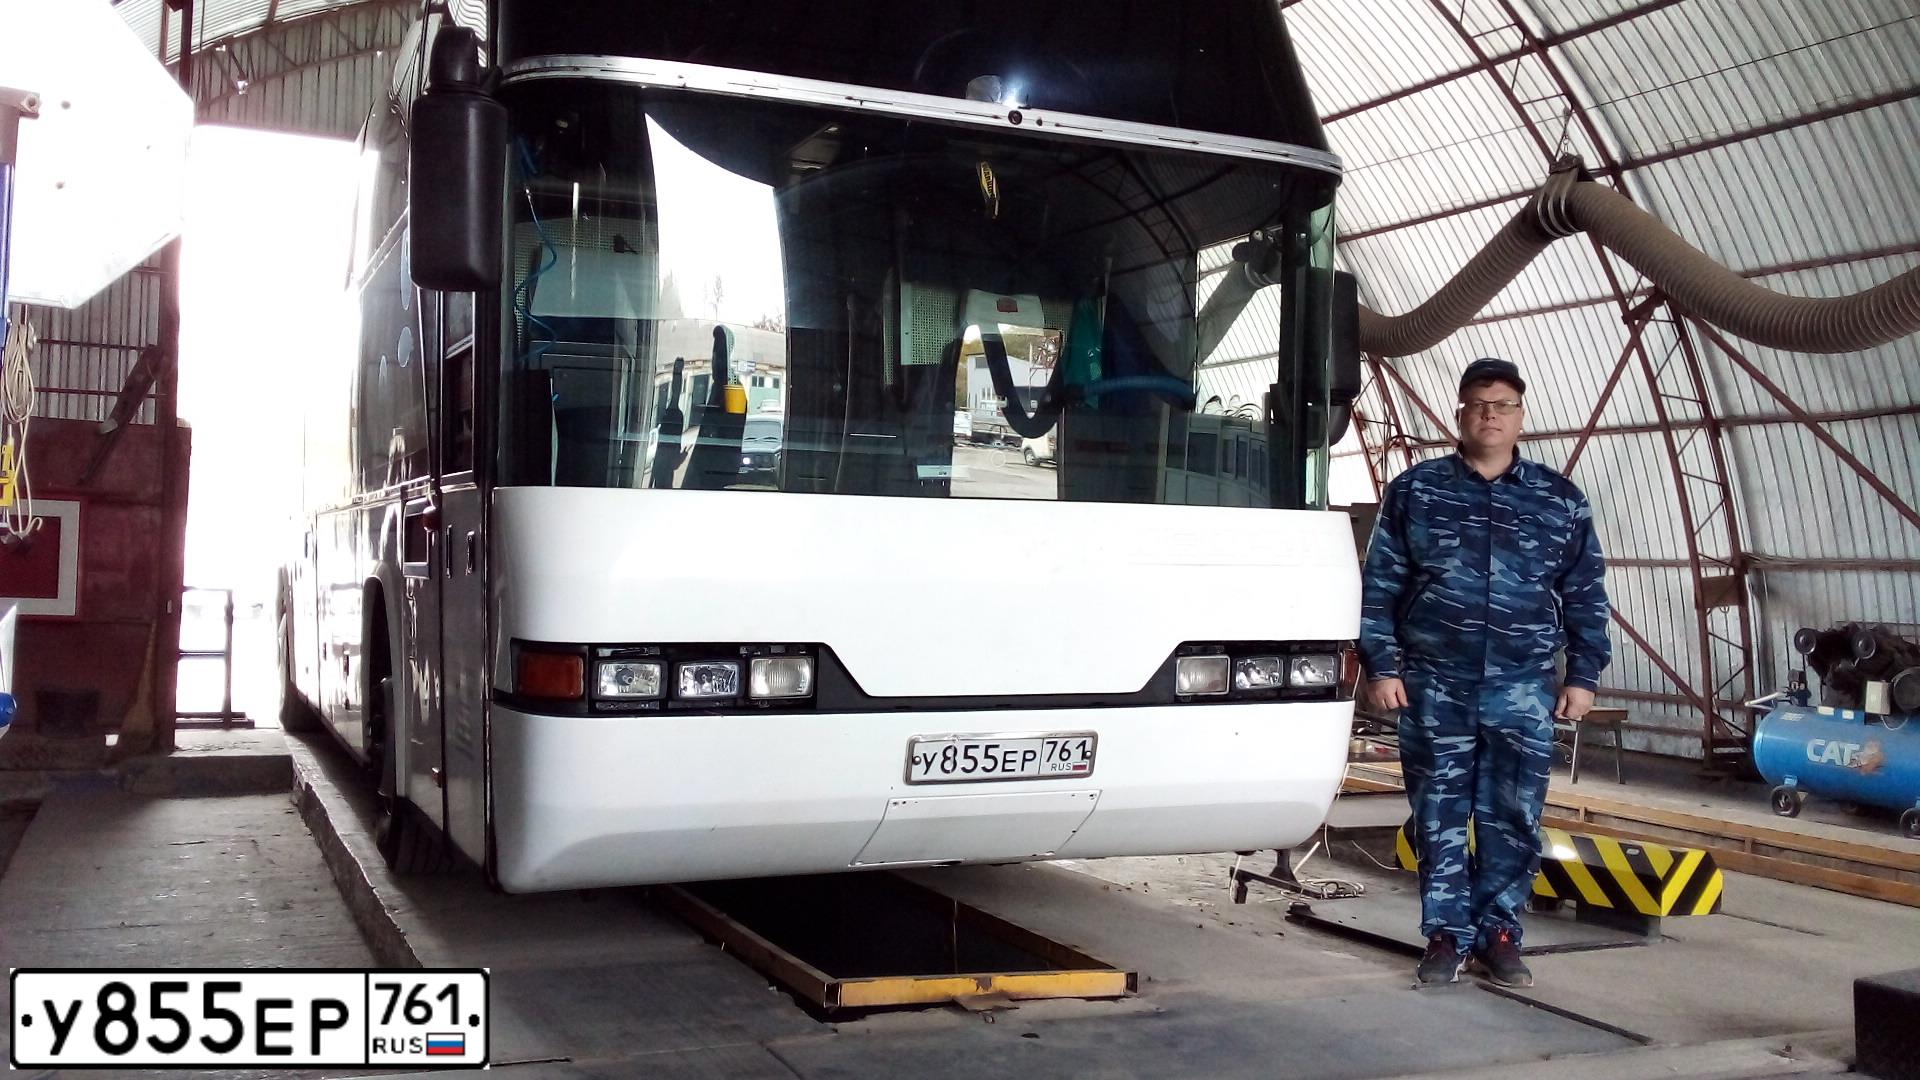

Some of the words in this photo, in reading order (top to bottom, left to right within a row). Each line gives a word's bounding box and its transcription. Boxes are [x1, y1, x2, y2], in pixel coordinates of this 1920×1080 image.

[1046, 739, 1088, 763] 761
[1807, 738, 1860, 767] CAT
[1050, 762, 1072, 771] RUS
